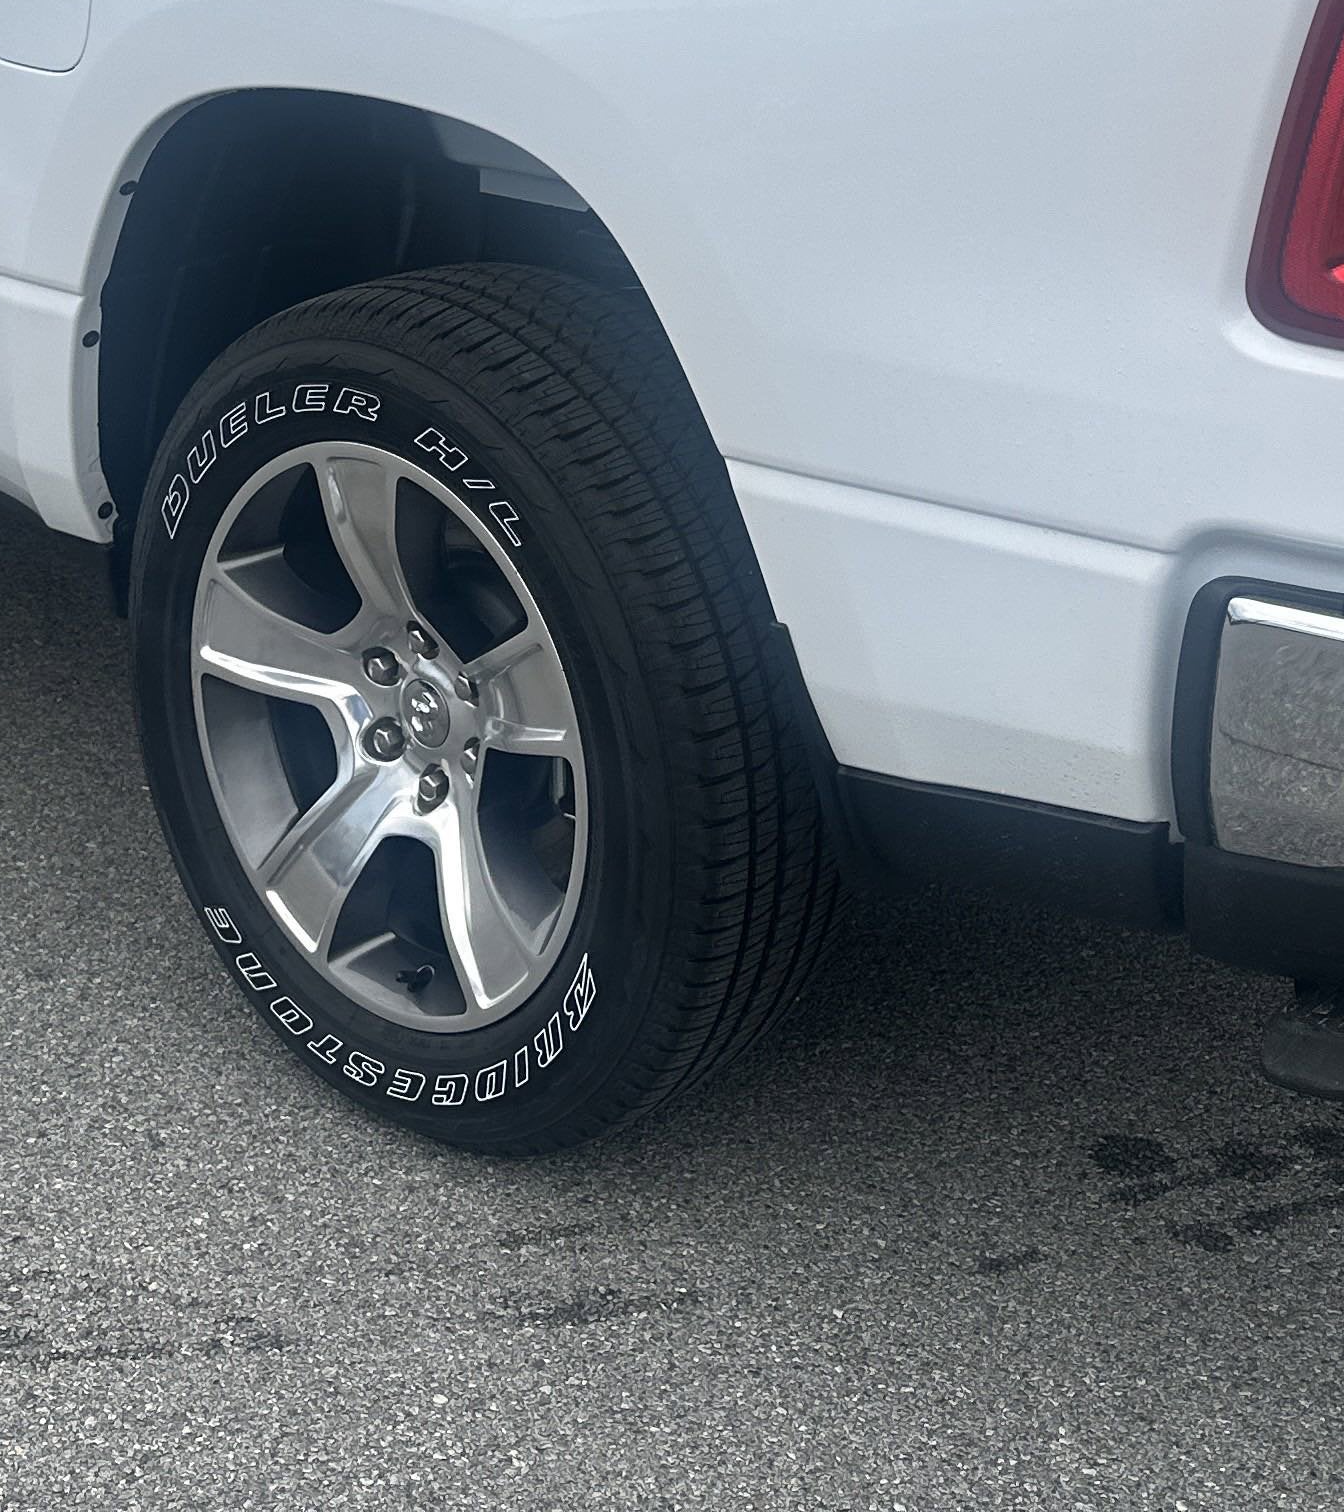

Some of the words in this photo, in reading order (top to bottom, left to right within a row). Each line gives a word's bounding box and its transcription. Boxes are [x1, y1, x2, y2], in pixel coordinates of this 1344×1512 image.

[160, 383, 382, 539] DUELER
[414, 427, 523, 547] H/L
[204, 906, 597, 1107] BRIDGESTONE
